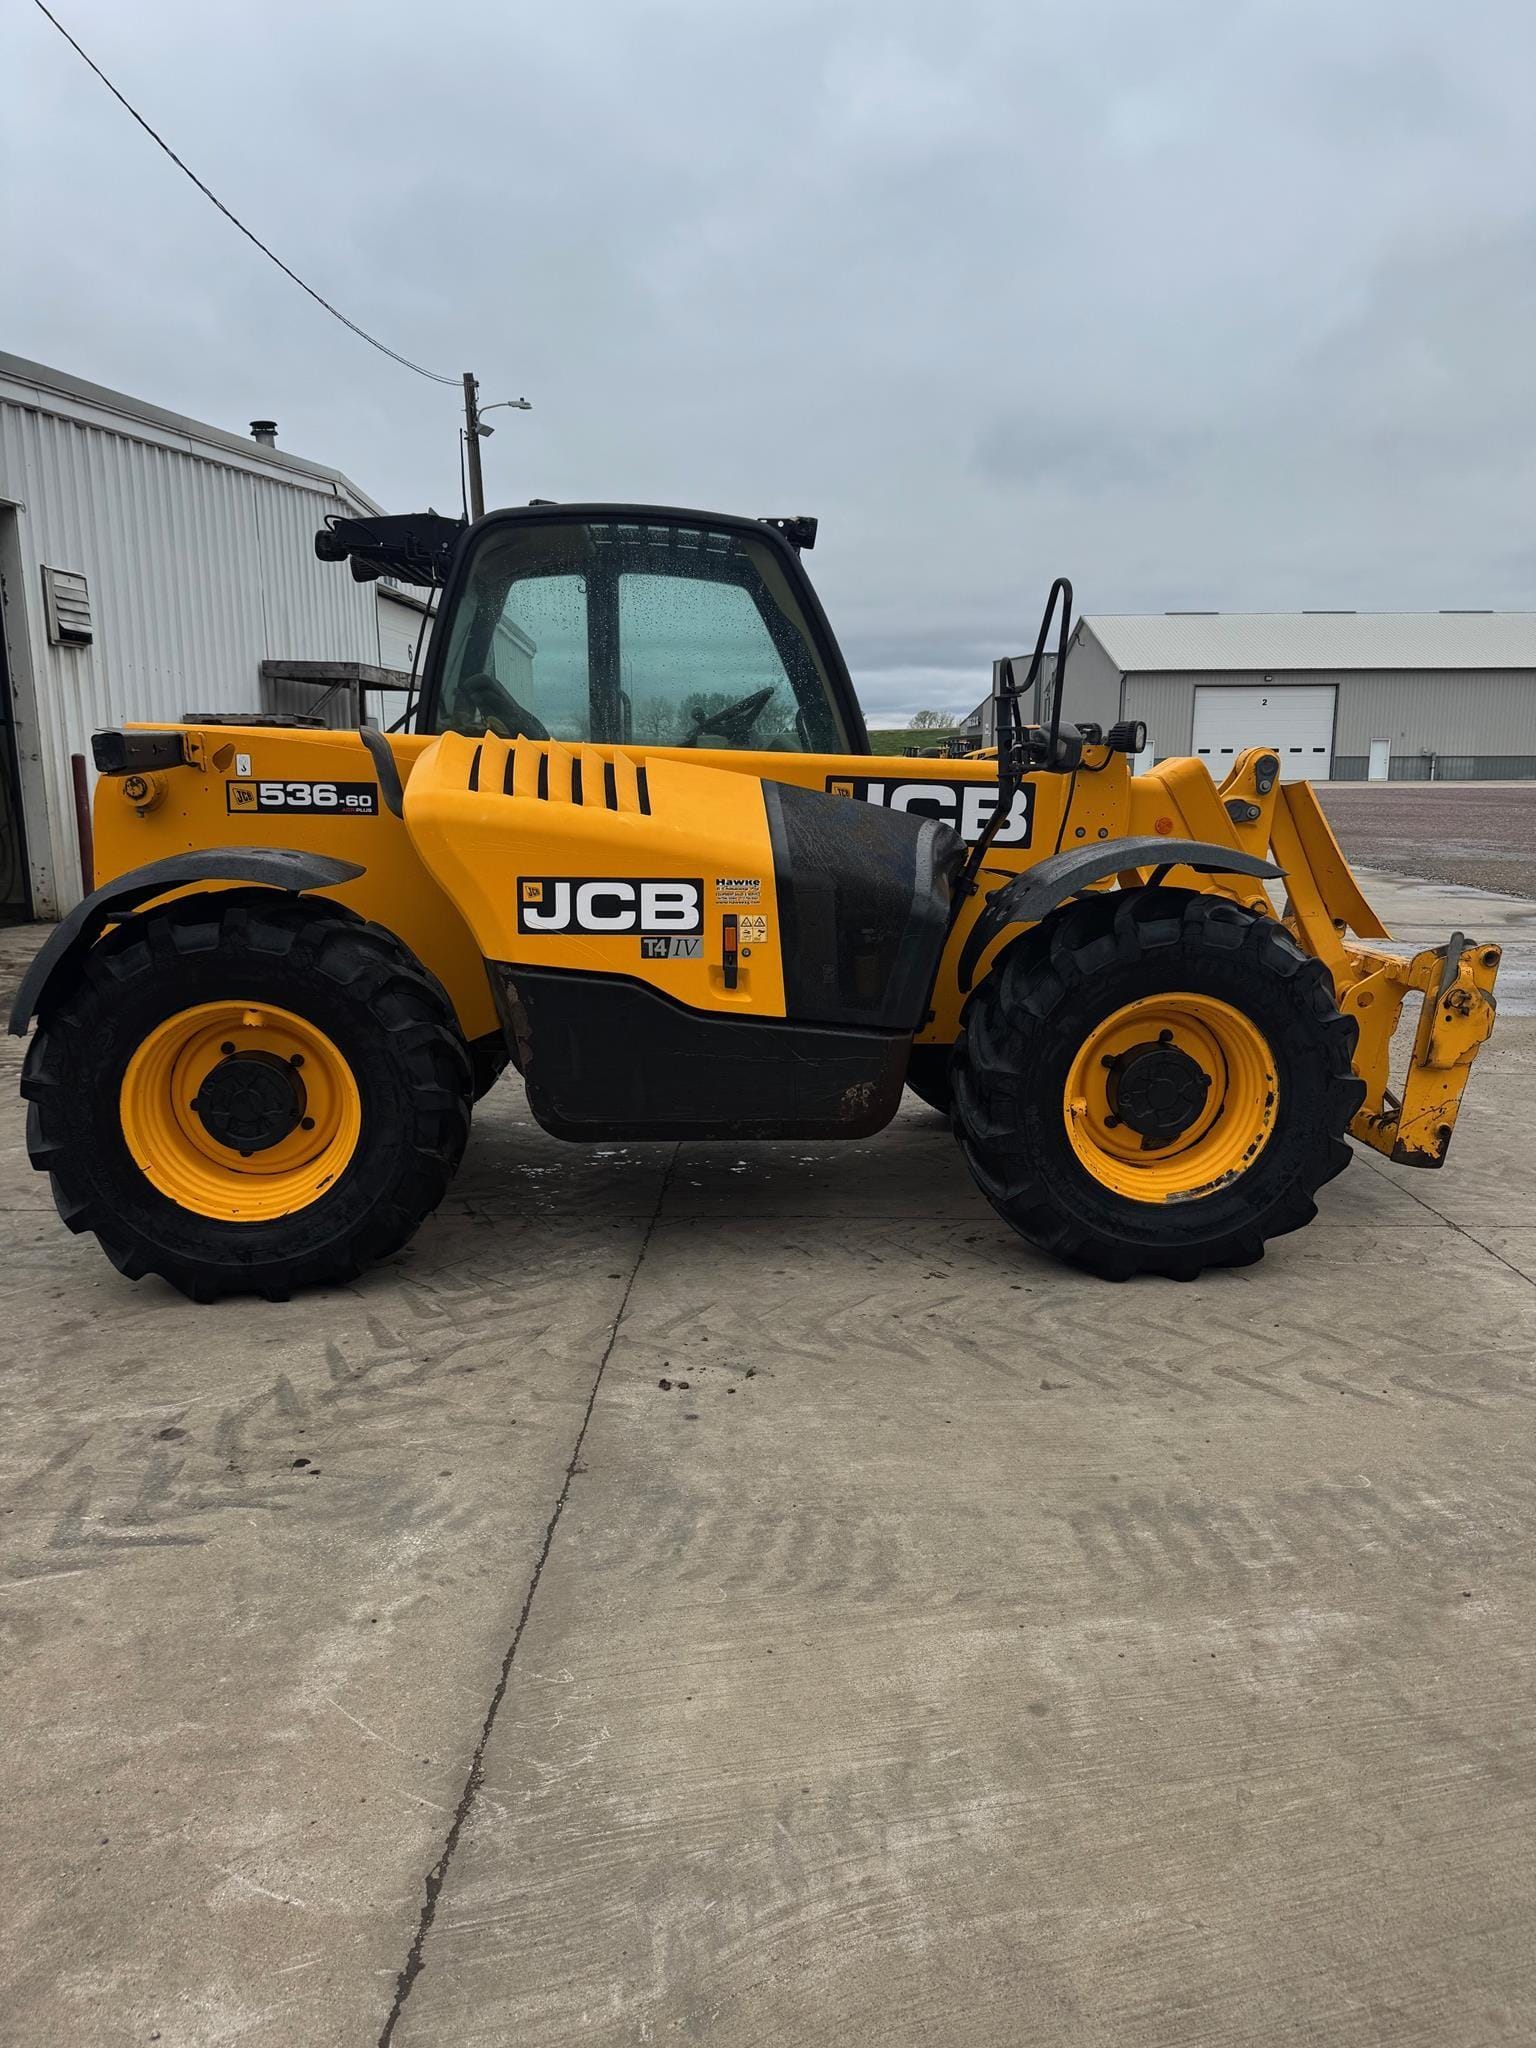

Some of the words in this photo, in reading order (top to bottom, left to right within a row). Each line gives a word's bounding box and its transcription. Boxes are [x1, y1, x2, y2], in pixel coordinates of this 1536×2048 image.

[407, 643, 413, 662] 6
[259, 783, 372, 807] 536-60
[523, 882, 700, 930] JCB
[643, 938, 668, 957] T4
[672, 938, 701, 957] IV
